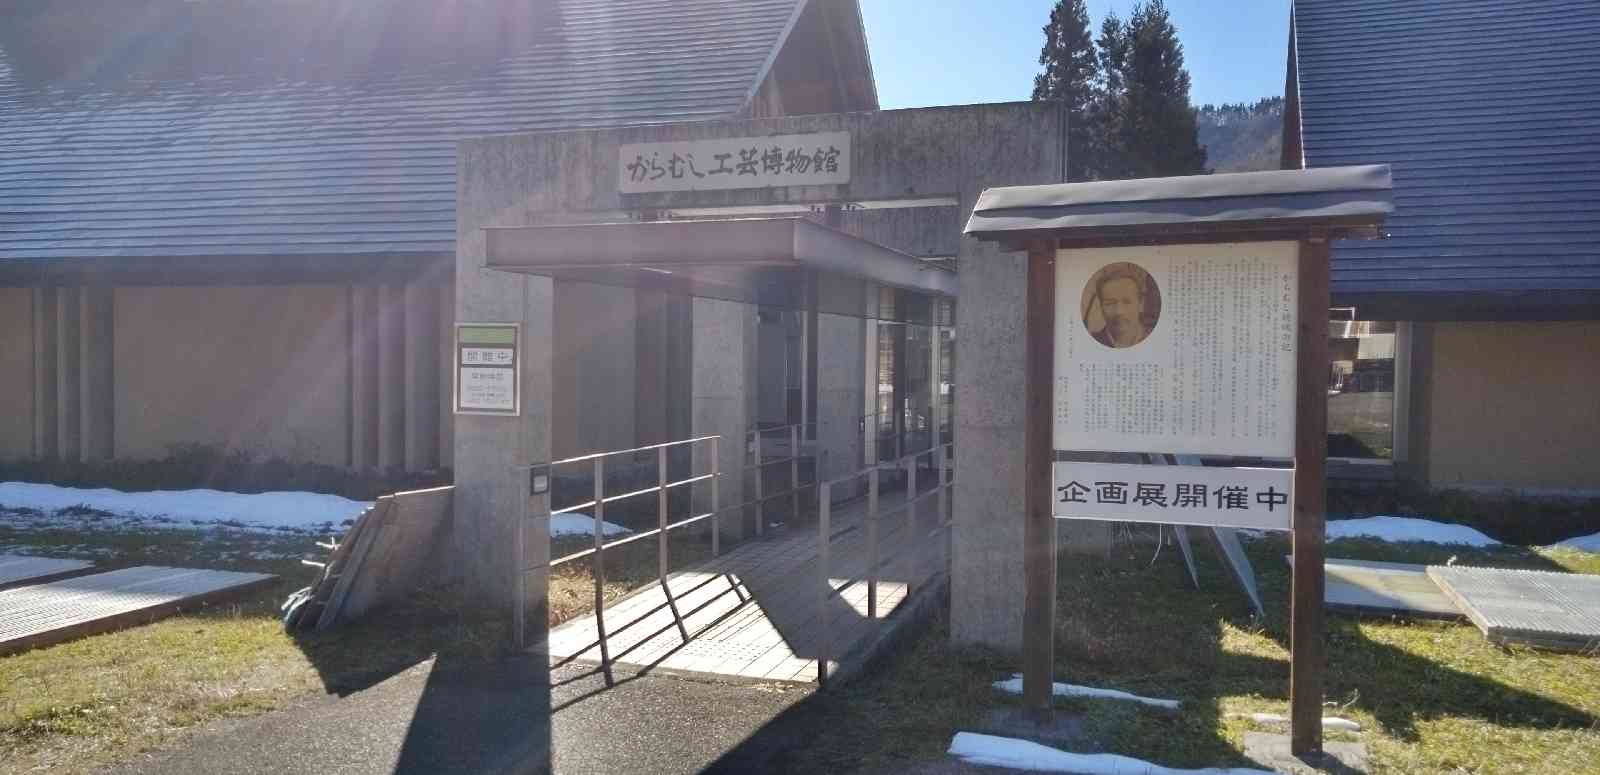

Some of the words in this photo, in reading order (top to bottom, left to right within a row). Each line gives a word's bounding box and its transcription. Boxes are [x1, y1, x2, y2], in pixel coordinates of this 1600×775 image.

[626, 145, 841, 183] からむし工芸博物館
[1056, 480, 1288, 512] 企画展開催中
